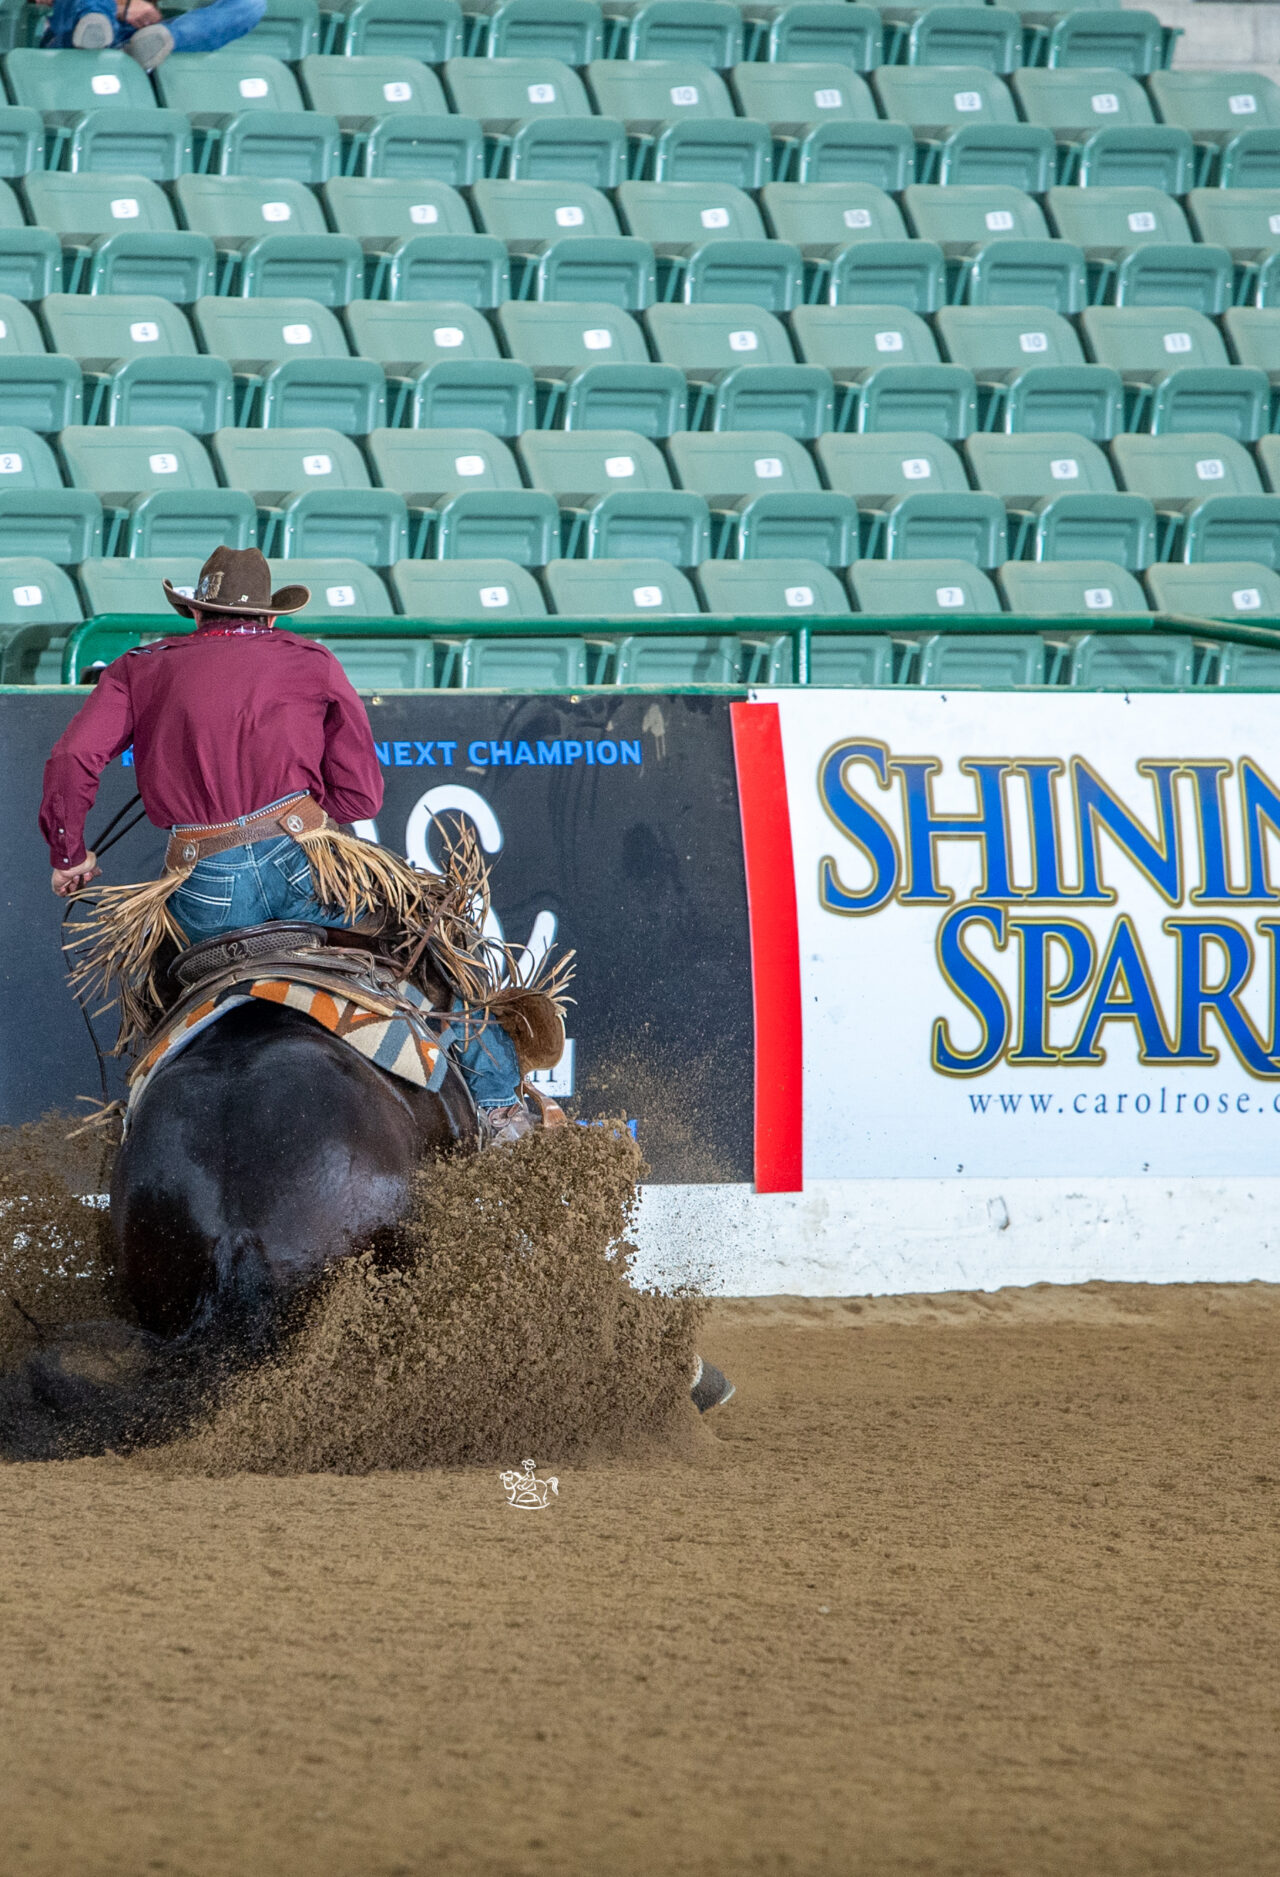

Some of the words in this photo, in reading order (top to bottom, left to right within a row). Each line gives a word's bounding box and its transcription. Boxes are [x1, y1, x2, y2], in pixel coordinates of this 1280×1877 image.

[373, 740, 458, 766] NEXT
[468, 740, 642, 766] CHAMPION
[931, 898, 1280, 1078] SPAR
